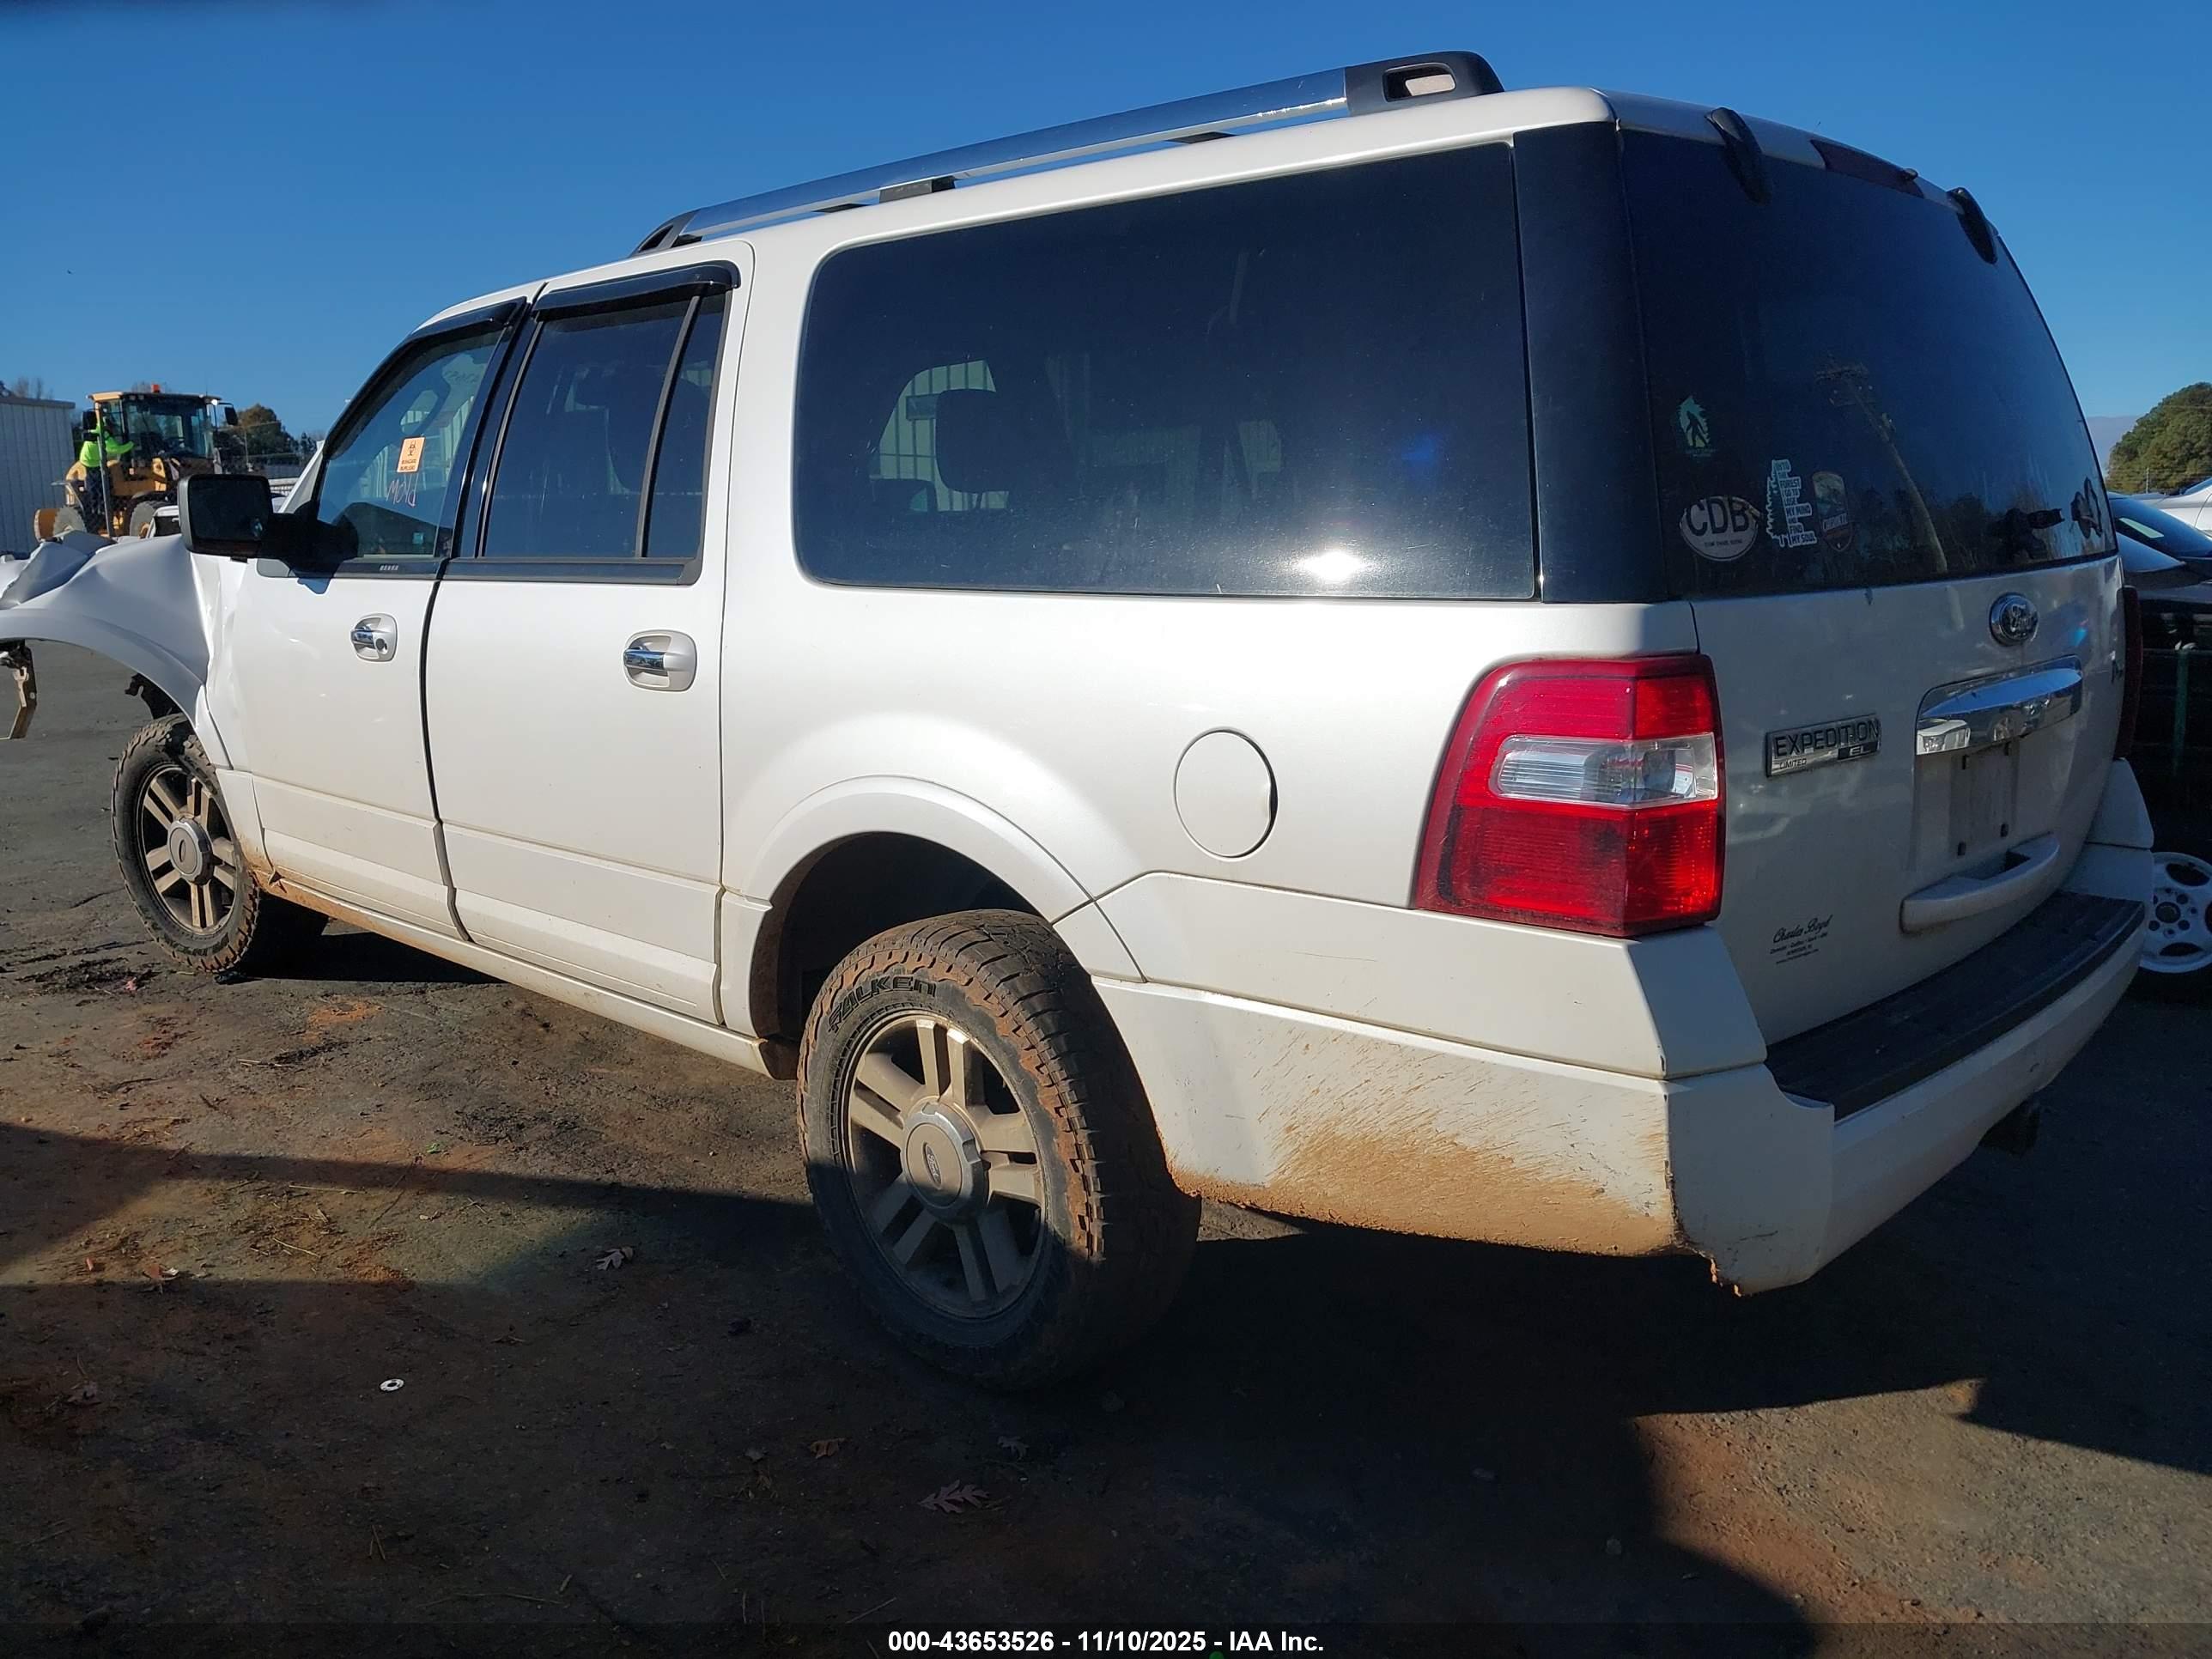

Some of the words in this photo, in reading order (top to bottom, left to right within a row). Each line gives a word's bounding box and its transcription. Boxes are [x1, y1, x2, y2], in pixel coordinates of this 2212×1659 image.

[1775, 461, 1790, 471] INTO
[1780, 478, 1801, 489] FOREST
[1786, 507, 1796, 517] MY
[1791, 533, 1800, 544] MY
[1800, 531, 1815, 542] SOUL
[1774, 718, 1881, 757] EXPEDITION
[1849, 744, 1871, 758] EL
[1779, 758, 1808, 769] LIMITED
[829, 975, 937, 1033] FALKEN
